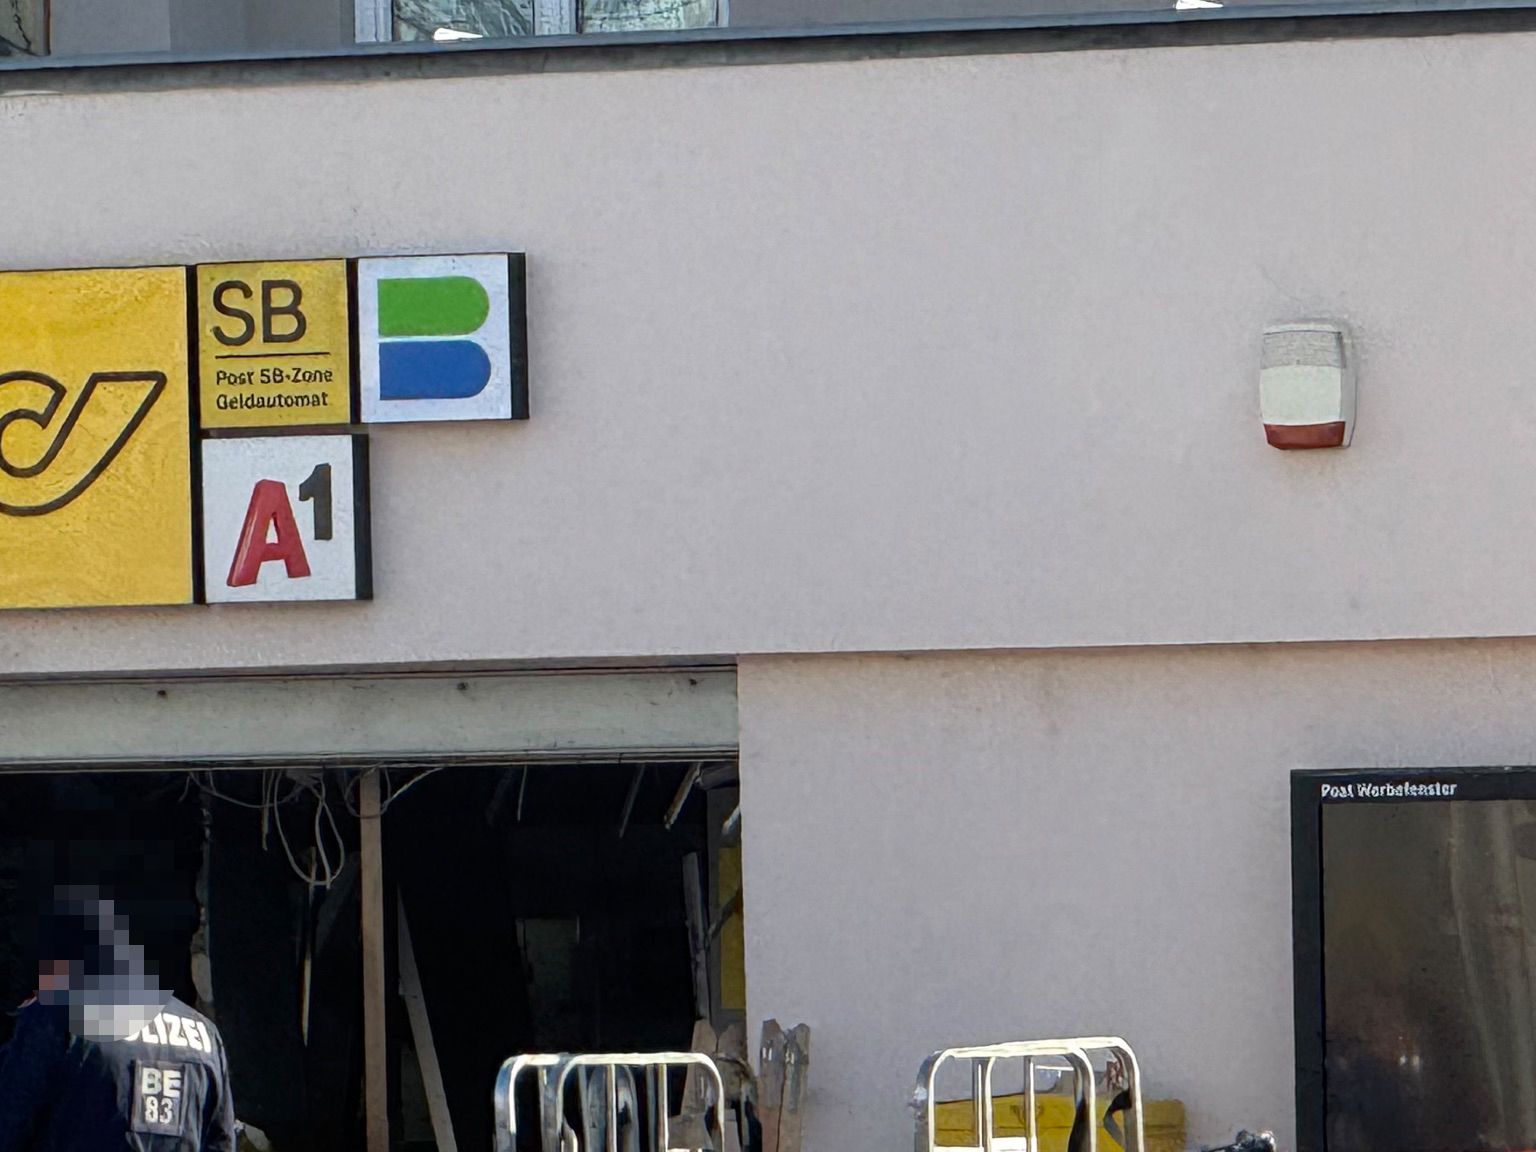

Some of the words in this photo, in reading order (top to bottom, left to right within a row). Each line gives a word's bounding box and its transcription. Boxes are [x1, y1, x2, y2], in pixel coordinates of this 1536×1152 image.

[212, 279, 307, 346] SB
[216, 369, 254, 385] Post
[260, 367, 333, 384] SB-Zone
[216, 391, 329, 410] Geldautomat
[226, 463, 333, 587] A1
[1320, 783, 1355, 799] Post
[1357, 781, 1458, 798] Werbefenster
[142, 1067, 182, 1099] BE
[144, 1096, 173, 1124] 83
